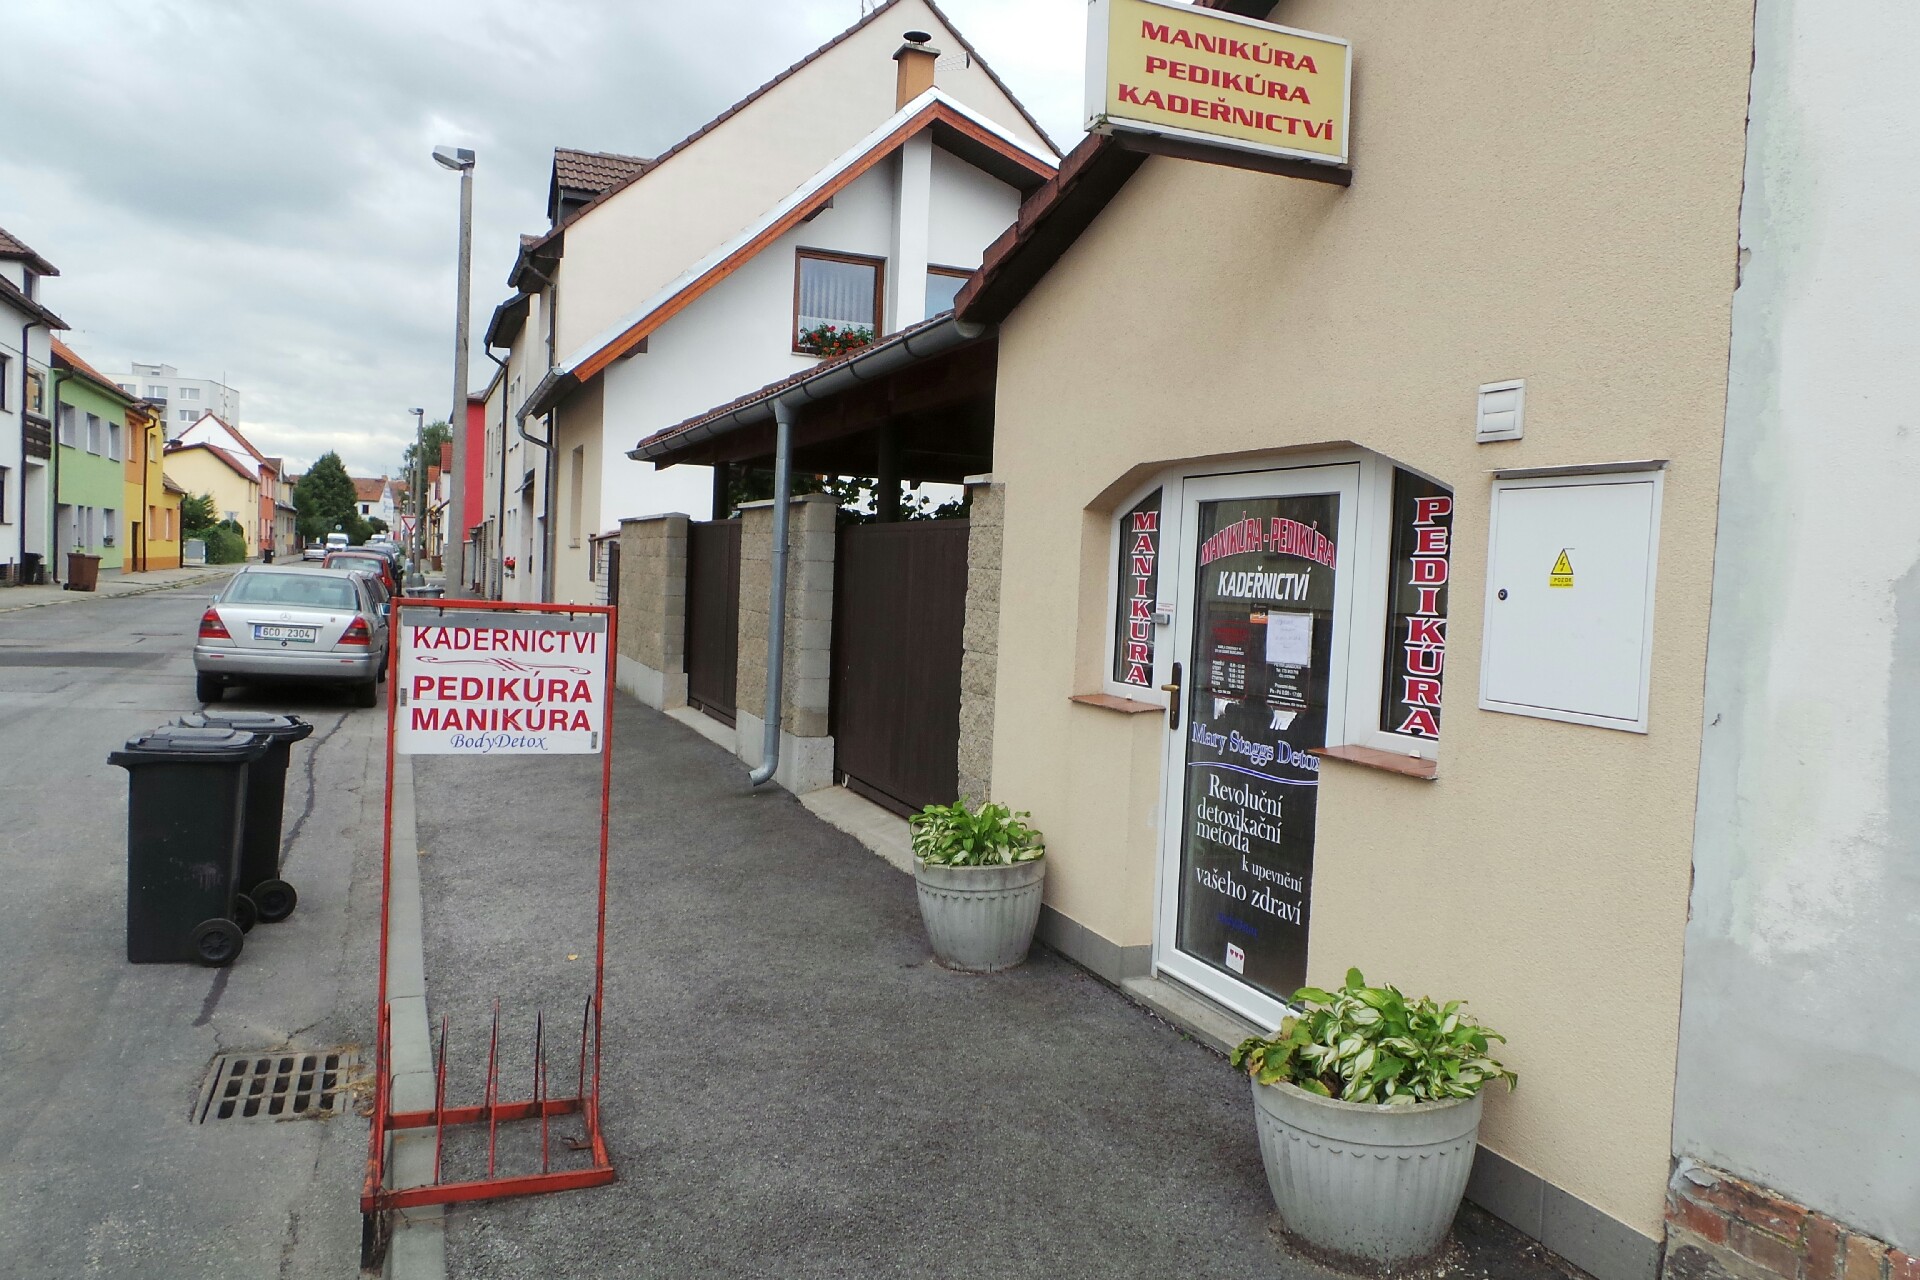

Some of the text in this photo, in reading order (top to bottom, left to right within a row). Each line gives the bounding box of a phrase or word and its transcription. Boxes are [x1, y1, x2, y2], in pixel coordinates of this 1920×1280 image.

[1141, 20, 1318, 74] MANIKÚRA
[1145, 55, 1311, 104] PEDIKÚRA
[1118, 83, 1334, 140] KADEŘNICTVÍ
[1200, 510, 1263, 567] MANIKÚRA
[1269, 517, 1336, 570] PEDIKÚRA
[1124, 511, 1158, 686] MANIKÚRA
[1217, 565, 1312, 601] KADEŘNICTVÍ
[1396, 496, 1452, 739] PEDIKÚRA
[412, 670, 593, 704] PEDIKÚRA
[411, 701, 592, 733] MANIKÚRA
[450, 731, 549, 754] BodyDetox
[1191, 721, 1228, 756] Mary
[1229, 729, 1275, 767] Staggs
[1208, 773, 1284, 819] Revoluční
[1196, 821, 1250, 854] metoda
[1197, 796, 1283, 845] detoxikační
[1196, 867, 1247, 901] vašeho
[1250, 886, 1303, 926] zdraví
[1241, 854, 1303, 894] k upevnění
